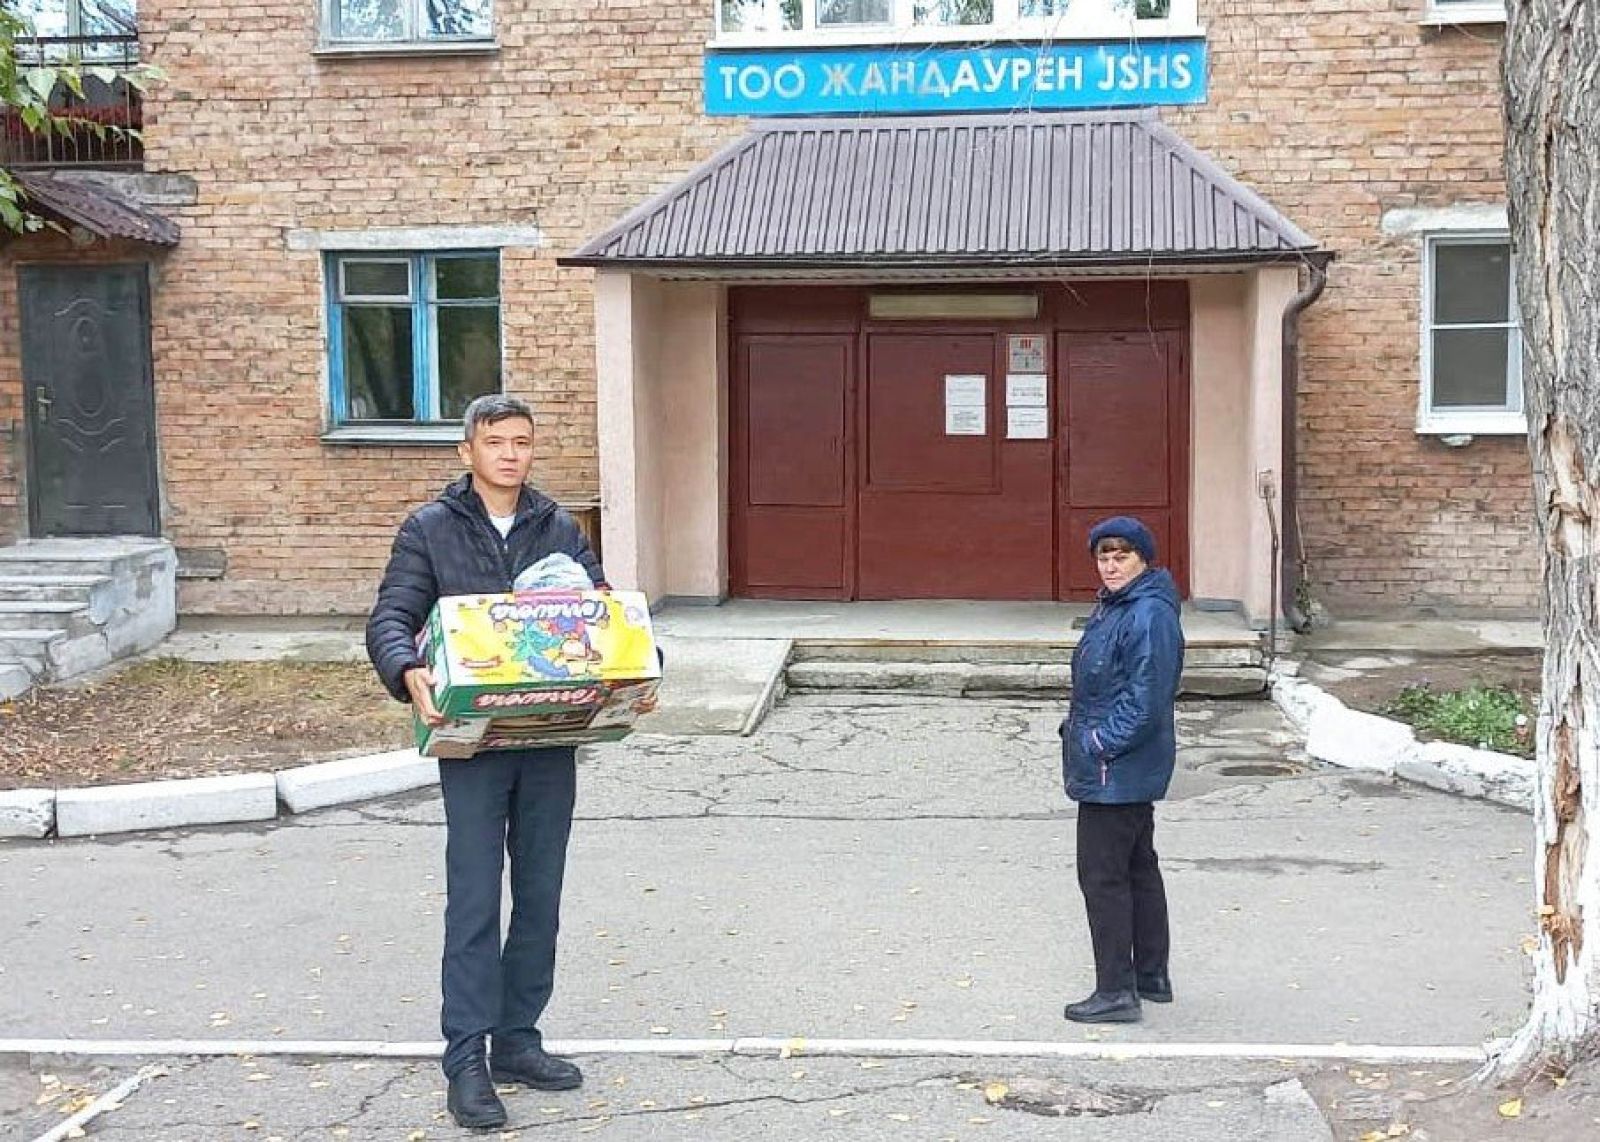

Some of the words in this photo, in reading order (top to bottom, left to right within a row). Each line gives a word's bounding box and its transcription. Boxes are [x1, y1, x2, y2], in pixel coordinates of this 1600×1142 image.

[719, 63, 806, 100] ТОО
[819, 55, 1084, 98] ЖАНДАУРЕН
[1097, 52, 1192, 92] JSHS
